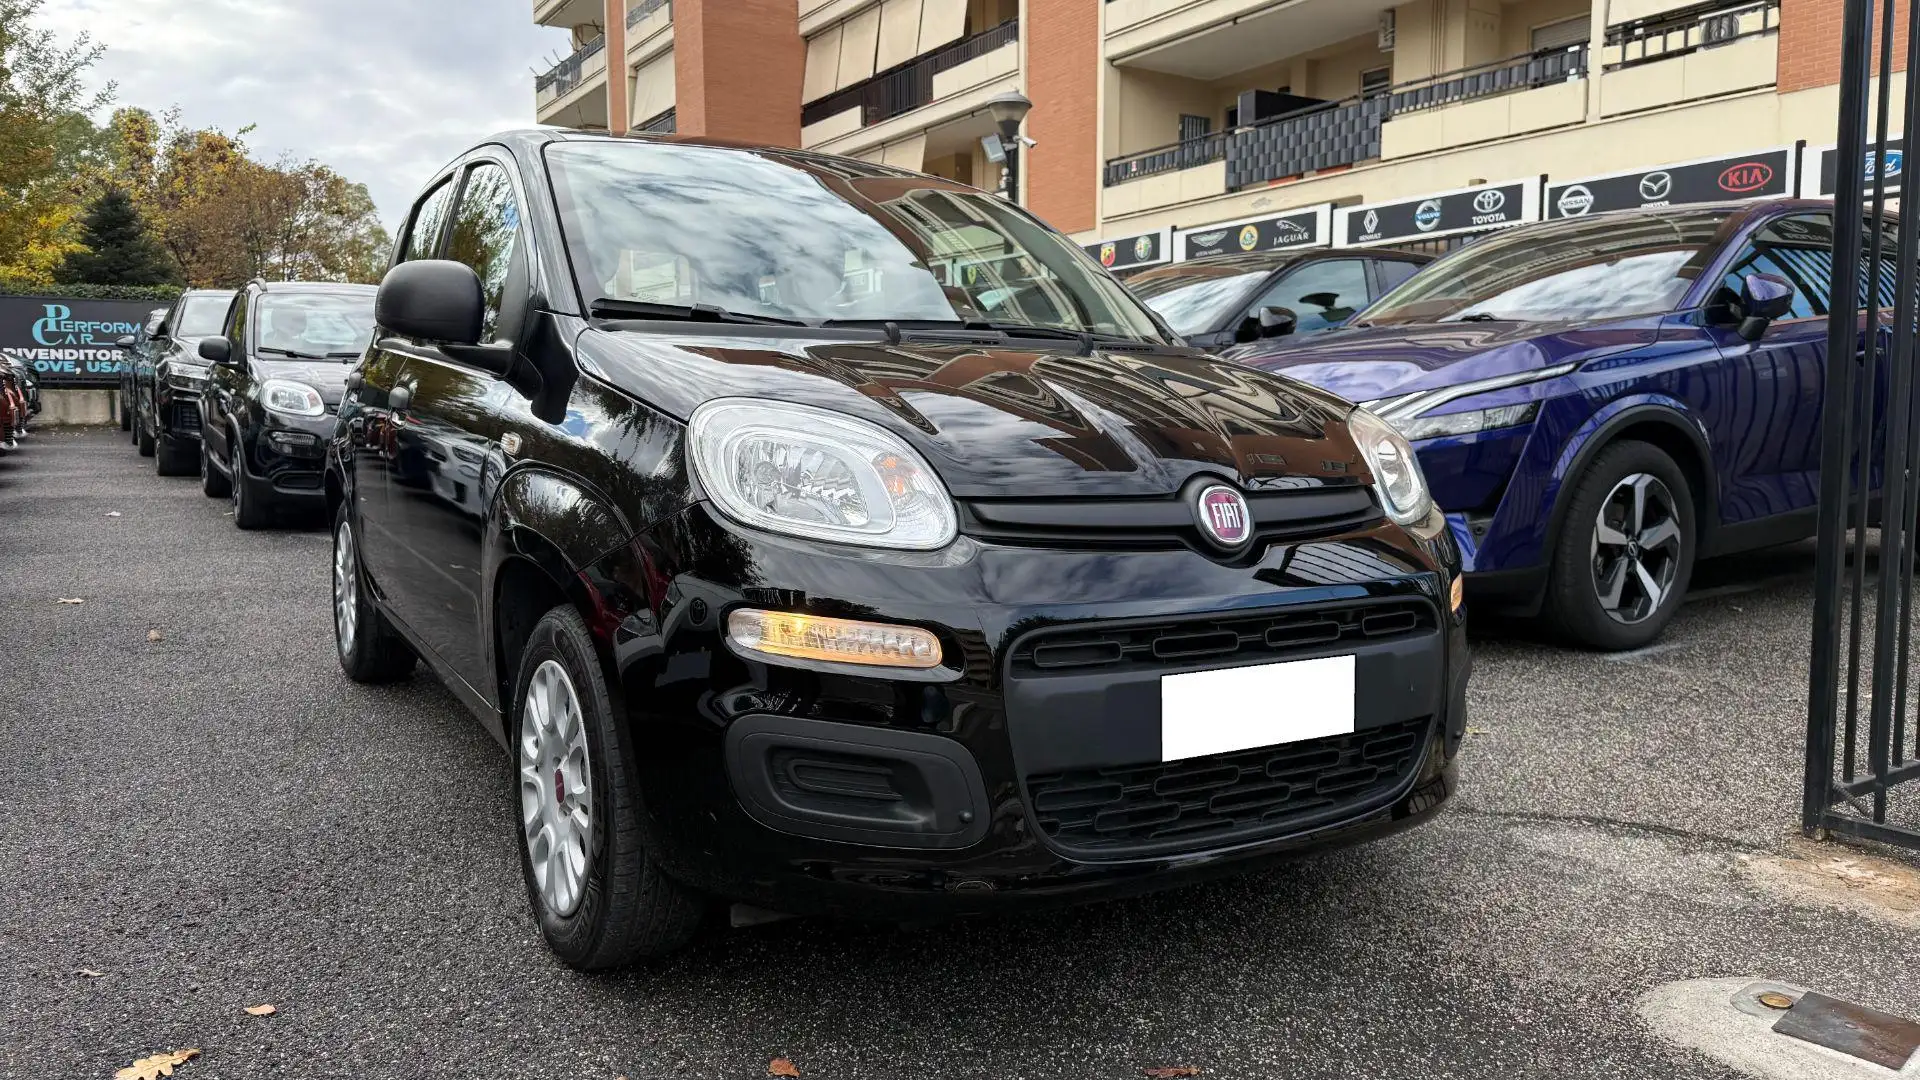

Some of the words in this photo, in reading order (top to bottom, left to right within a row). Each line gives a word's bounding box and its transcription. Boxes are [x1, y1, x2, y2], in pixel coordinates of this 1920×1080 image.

[1728, 168, 1764, 186] KIA
[1561, 197, 1590, 208] NISSAN
[1472, 212, 1506, 225] TOYOTA
[1273, 231, 1310, 246] JAGUAR
[86, 361, 121, 372] USA
[1211, 502, 1241, 529] FIAT
